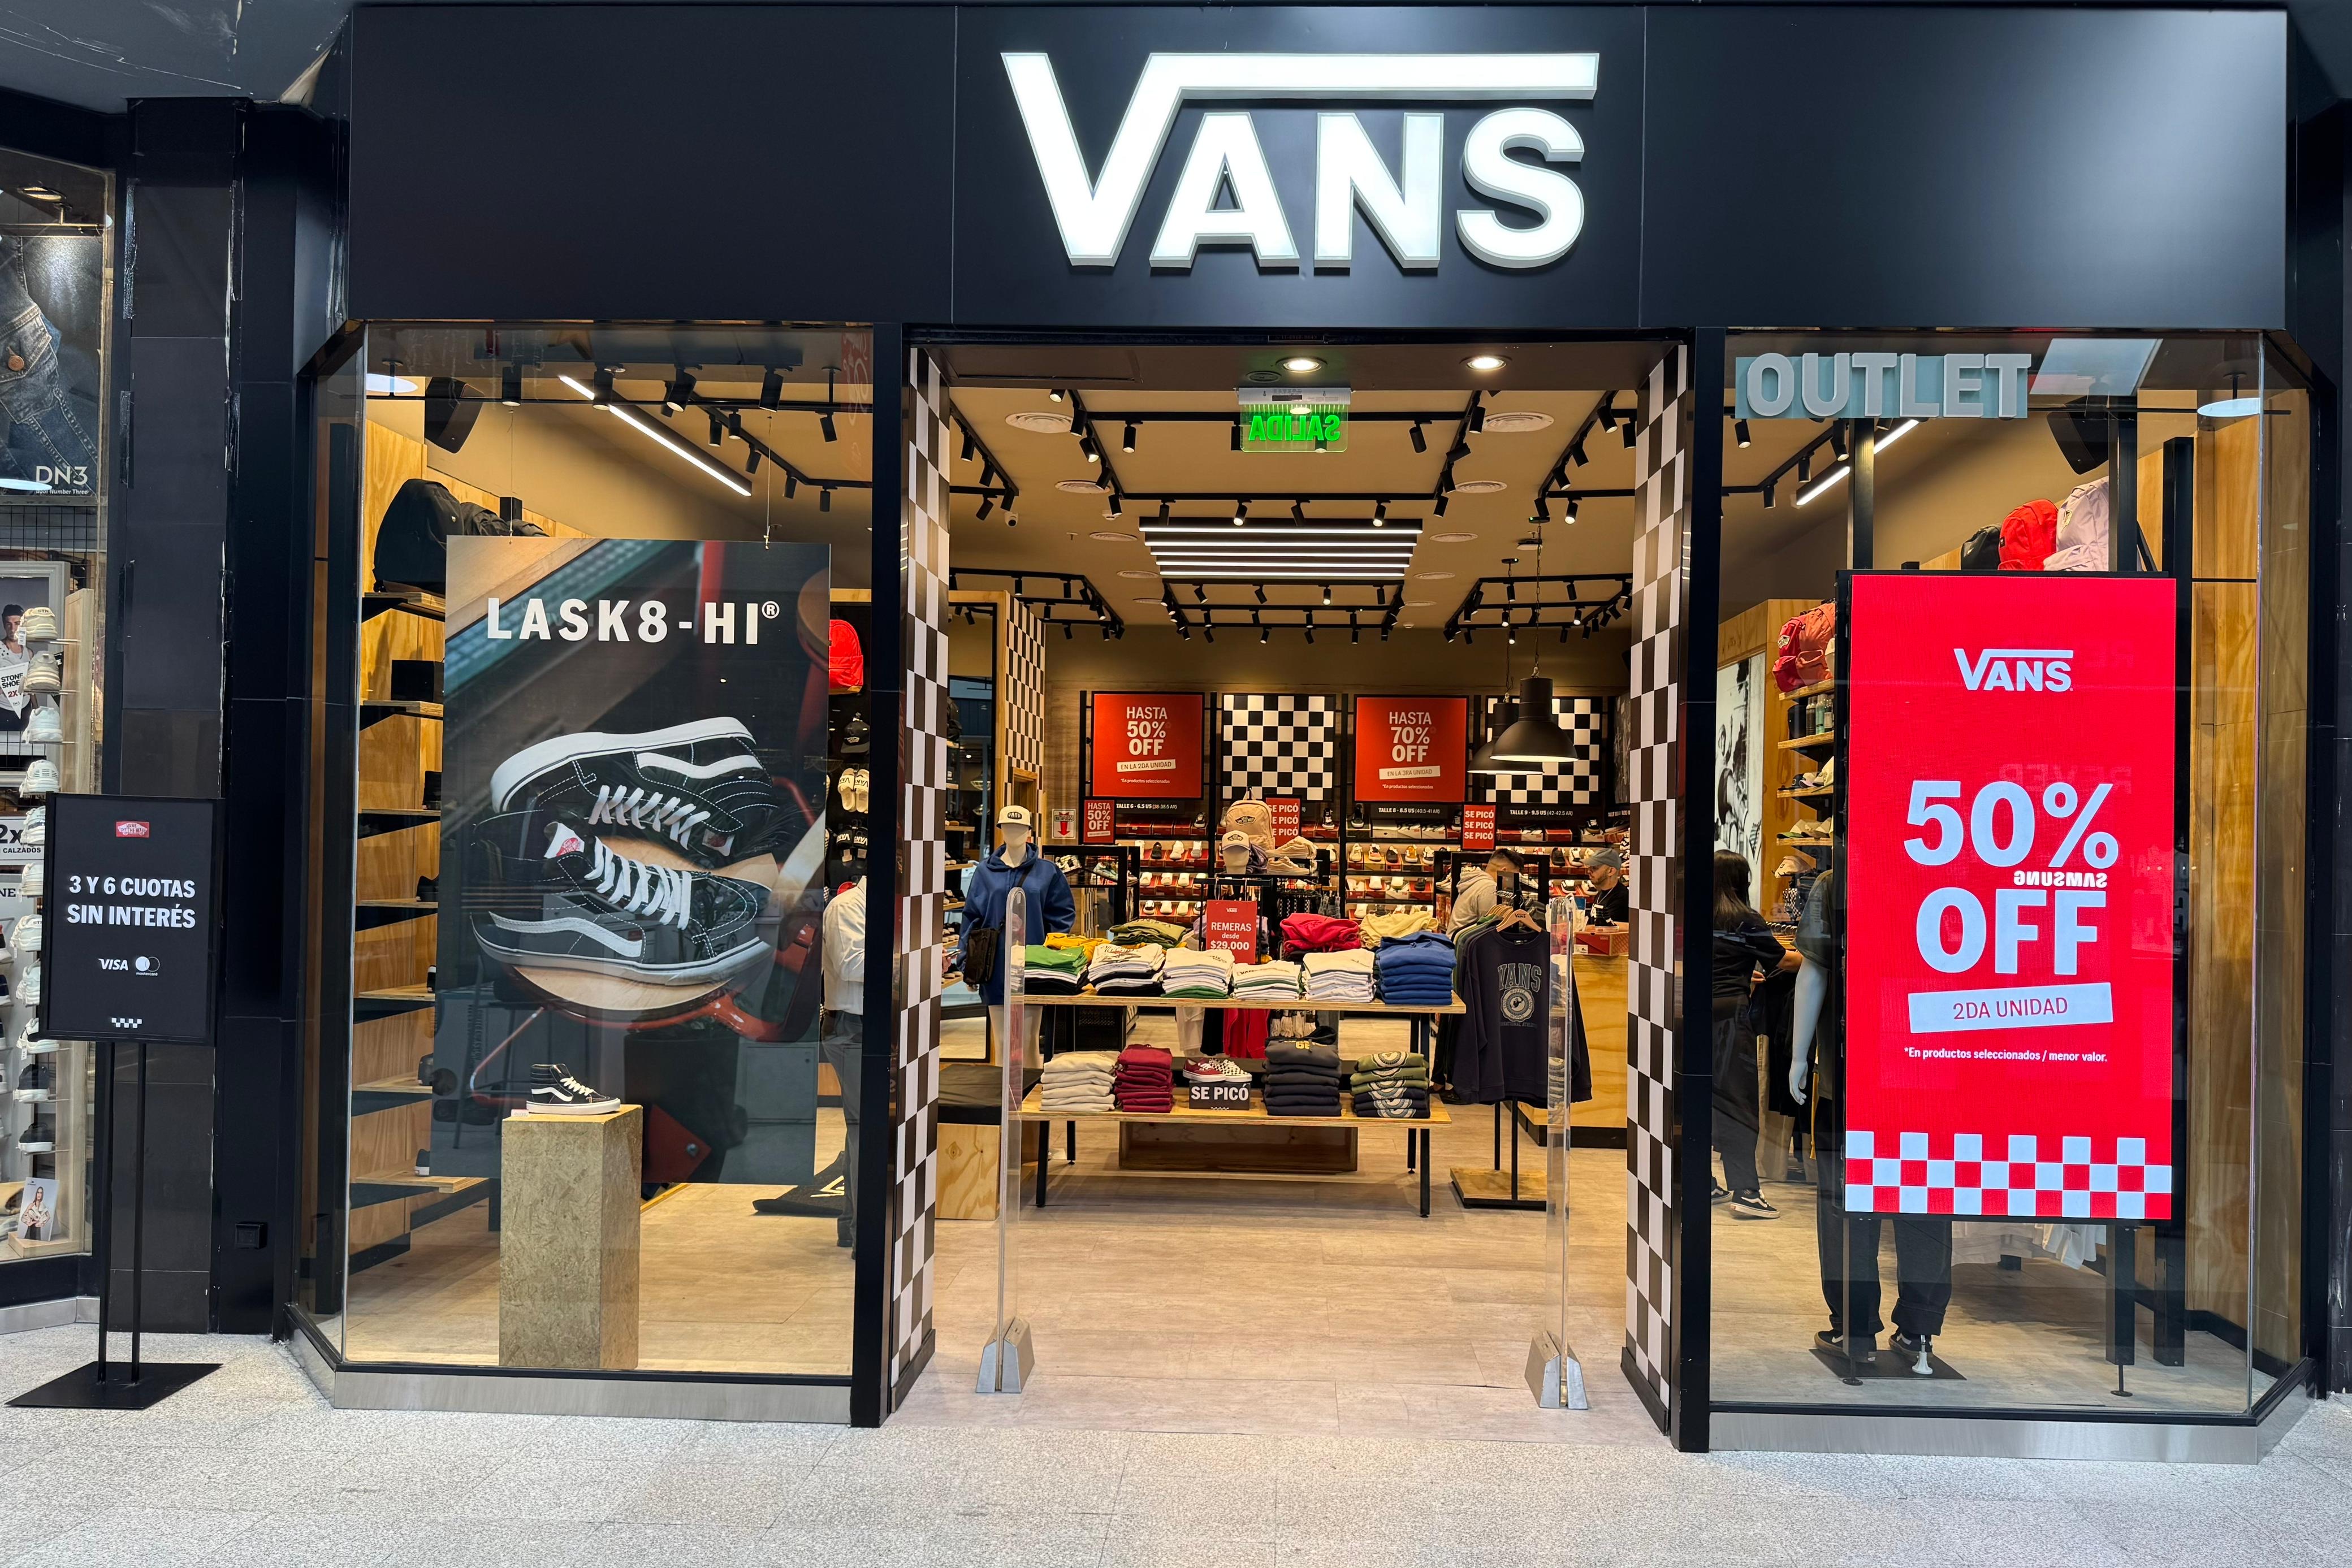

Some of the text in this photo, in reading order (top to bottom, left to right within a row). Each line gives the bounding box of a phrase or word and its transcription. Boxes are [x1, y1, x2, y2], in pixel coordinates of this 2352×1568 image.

[1000, 52, 1599, 269] VANS
[1747, 352, 2031, 417] OUTLET
[36, 466, 88, 485] DN3
[1953, 648, 2074, 692] VANS
[1126, 706, 1168, 720] HASTA
[1389, 712, 1432, 725] HASTA
[1126, 721, 1166, 738] 50%
[1390, 726, 1430, 744] 70%
[1129, 738, 1164, 756] OFF
[1391, 744, 1428, 762] OFF
[1087, 810, 1111, 820] 50%
[1279, 803, 1299, 813] PICÓ
[1476, 809, 1494, 818] PICÓ
[1088, 820, 1109, 830] OFF
[1278, 815, 1298, 825] PICÓ
[1475, 820, 1494, 829] PICÓ
[1903, 779, 2119, 869] 50%
[1278, 828, 1298, 836] PICÓ
[1475, 831, 1493, 840] PICÓ
[69, 876, 196, 898] 3 Y 6 CUOTAS
[67, 903, 196, 929] SIN INTERÉS
[1211, 922, 1252, 932] REMERAS
[1916, 886, 2107, 975] OFF
[1210, 939, 1250, 950] $29.000
[98, 958, 129, 971] VISA
[1497, 963, 1542, 993] VANS
[1953, 997, 2068, 1020] 2DA UNIDAD
[1922, 1047, 1971, 1060] productos
[1973, 1049, 2040, 1061] seleccionados
[2048, 1052, 2080, 1062] menor
[2081, 1051, 2108, 1062] valor.
[1191, 1083, 1249, 1101] SE PICÓ
